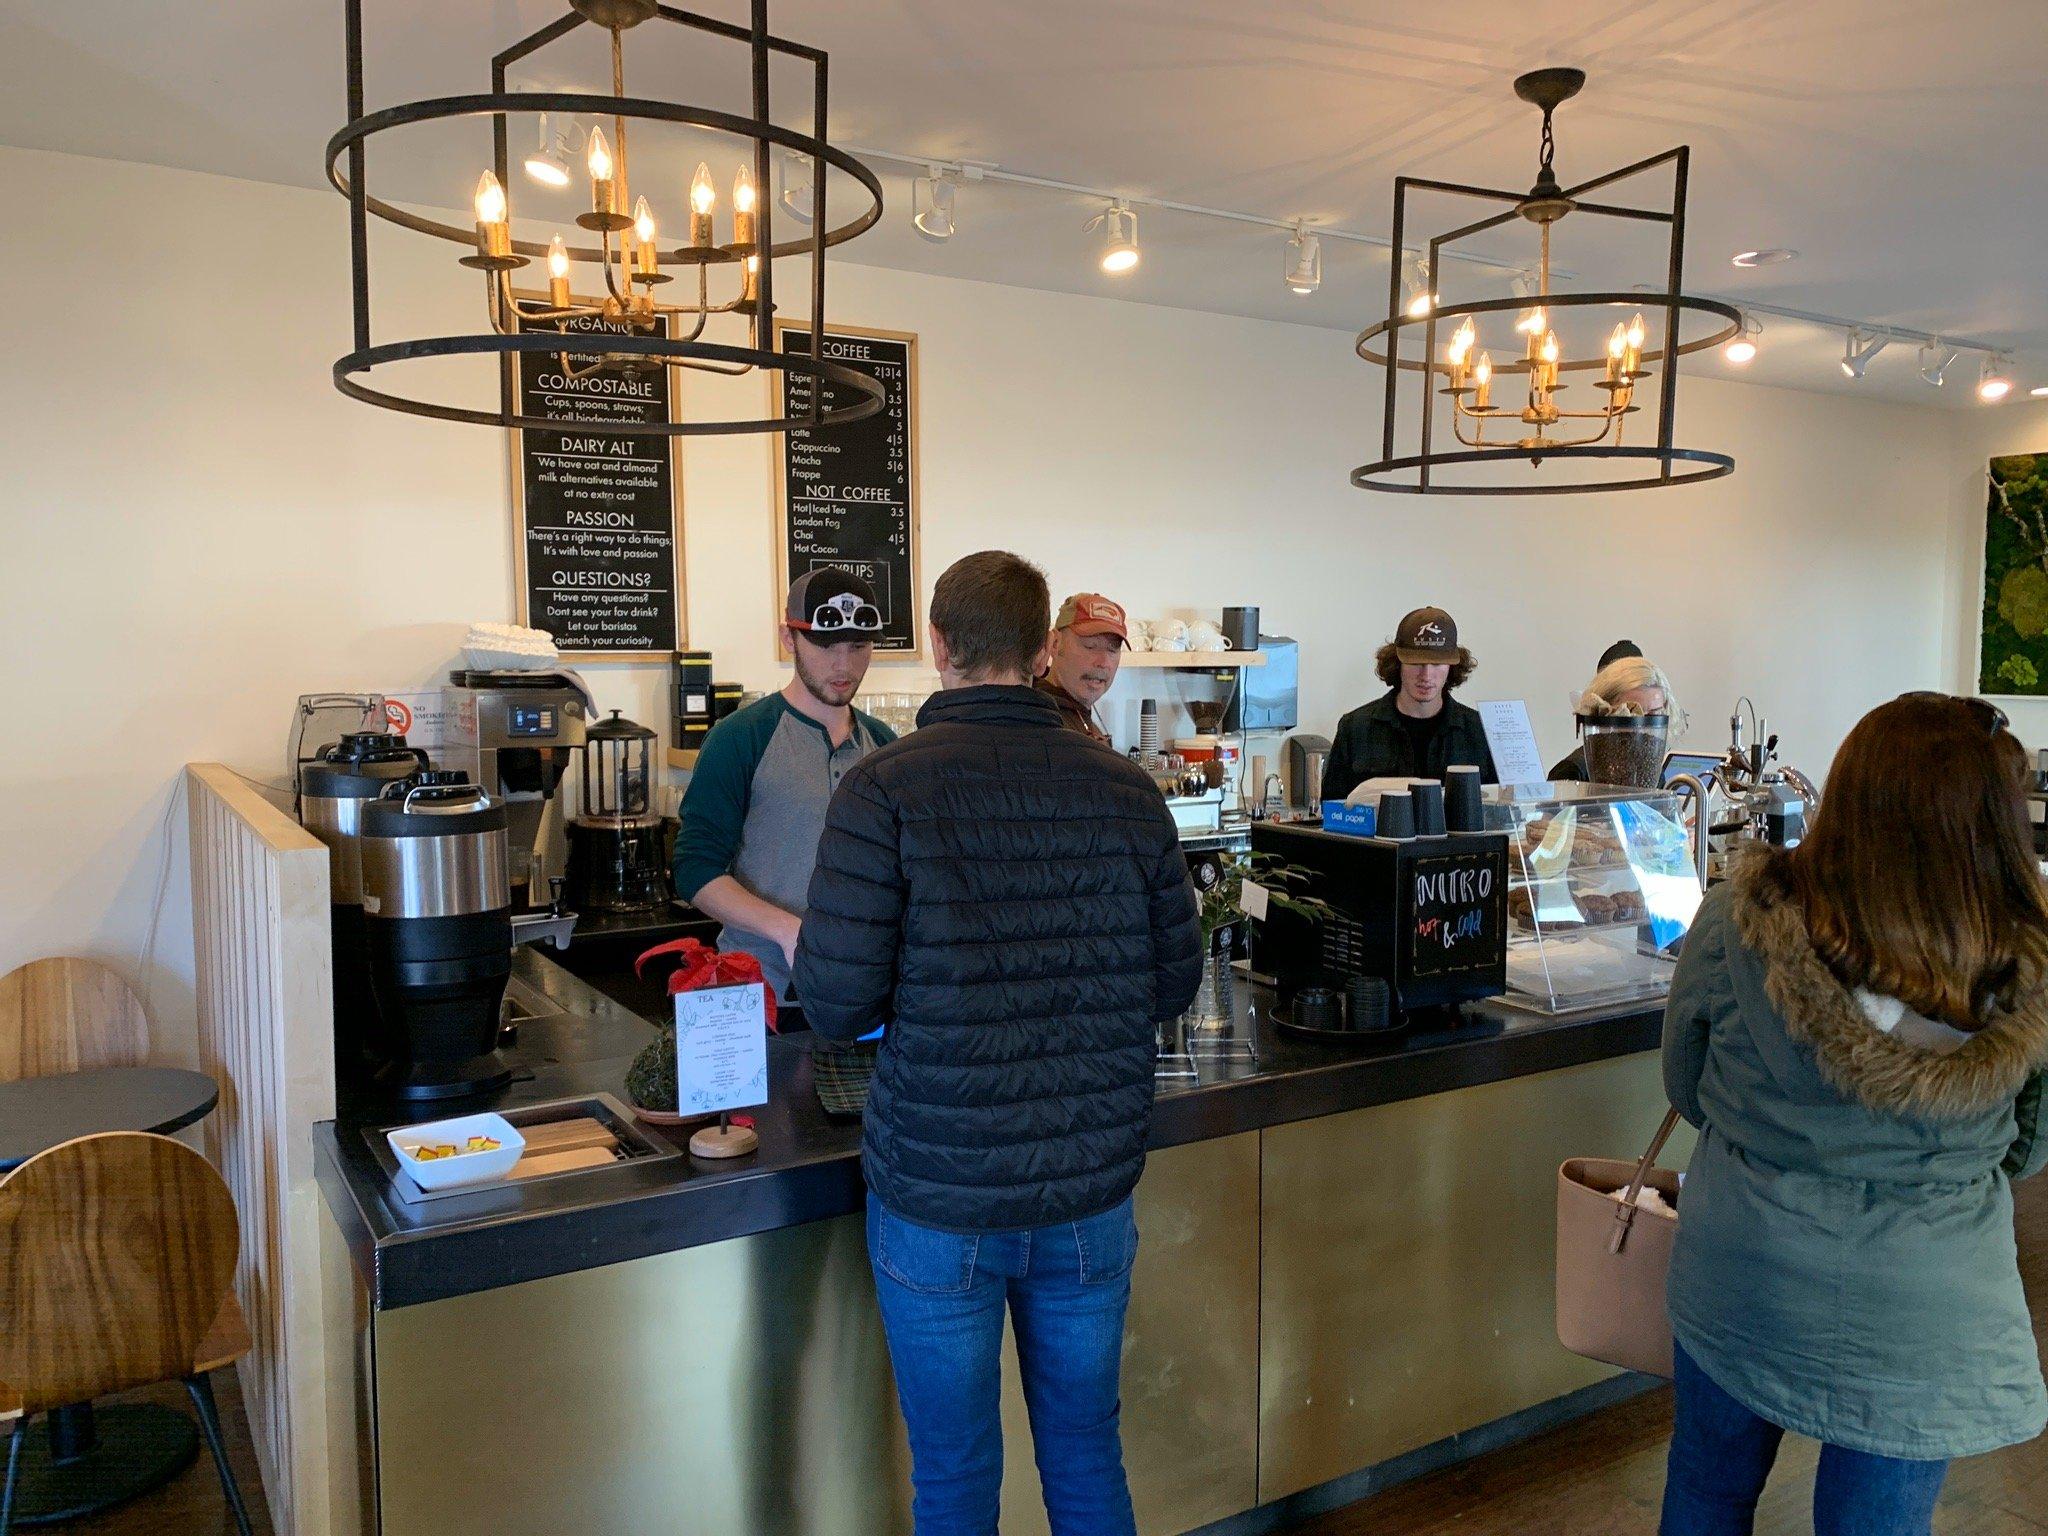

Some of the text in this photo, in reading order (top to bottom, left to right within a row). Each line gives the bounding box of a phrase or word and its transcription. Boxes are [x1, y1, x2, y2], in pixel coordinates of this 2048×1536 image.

[822, 342, 870, 359] COFFEE
[567, 353, 600, 363] ertified
[538, 374, 652, 397] COMPOSTABLE
[896, 382, 901, 391] 3
[544, 396, 572, 408] Cups,
[574, 401, 610, 411] spoons,
[888, 395, 902, 404] 3.5
[562, 412, 574, 420] all
[888, 408, 902, 418] 4.5
[896, 422, 902, 431] 5
[561, 437, 634, 455] DAIRY ALT
[791, 441, 903, 458] Cappuccino 3.5
[538, 457, 658, 473] We have oat and almond
[792, 455, 821, 465] Mocha
[538, 472, 658, 488] milk alternatives available
[792, 468, 904, 484] Frappe 6
[564, 490, 635, 500] at no extra cost
[806, 485, 891, 501] NOT COFFEE
[832, 506, 846, 514] Tea
[890, 508, 904, 517] 3.5
[566, 511, 634, 526] PASSION
[794, 517, 904, 530] London Fog 5
[528, 530, 560, 541] There's
[572, 532, 592, 544] right
[595, 535, 614, 546] way
[617, 534, 626, 542] to
[628, 533, 641, 544] do
[794, 530, 813, 539] Chai
[544, 546, 658, 560] It's with love and passion
[794, 543, 809, 552] Hot
[811, 545, 839, 554] Cocoa
[552, 570, 651, 587] QUESTIONS?
[553, 592, 649, 604] Have any questions?
[547, 606, 570, 616] Dont
[590, 609, 611, 619] your
[614, 606, 628, 616] fav
[631, 607, 658, 617] drink?
[568, 622, 581, 631] Let
[601, 622, 638, 631] baristas
[556, 636, 653, 648] quench your curiosity
[1417, 868, 1491, 906] NITRO
[1444, 922, 1458, 948] &
[698, 994, 714, 1003] TEA
